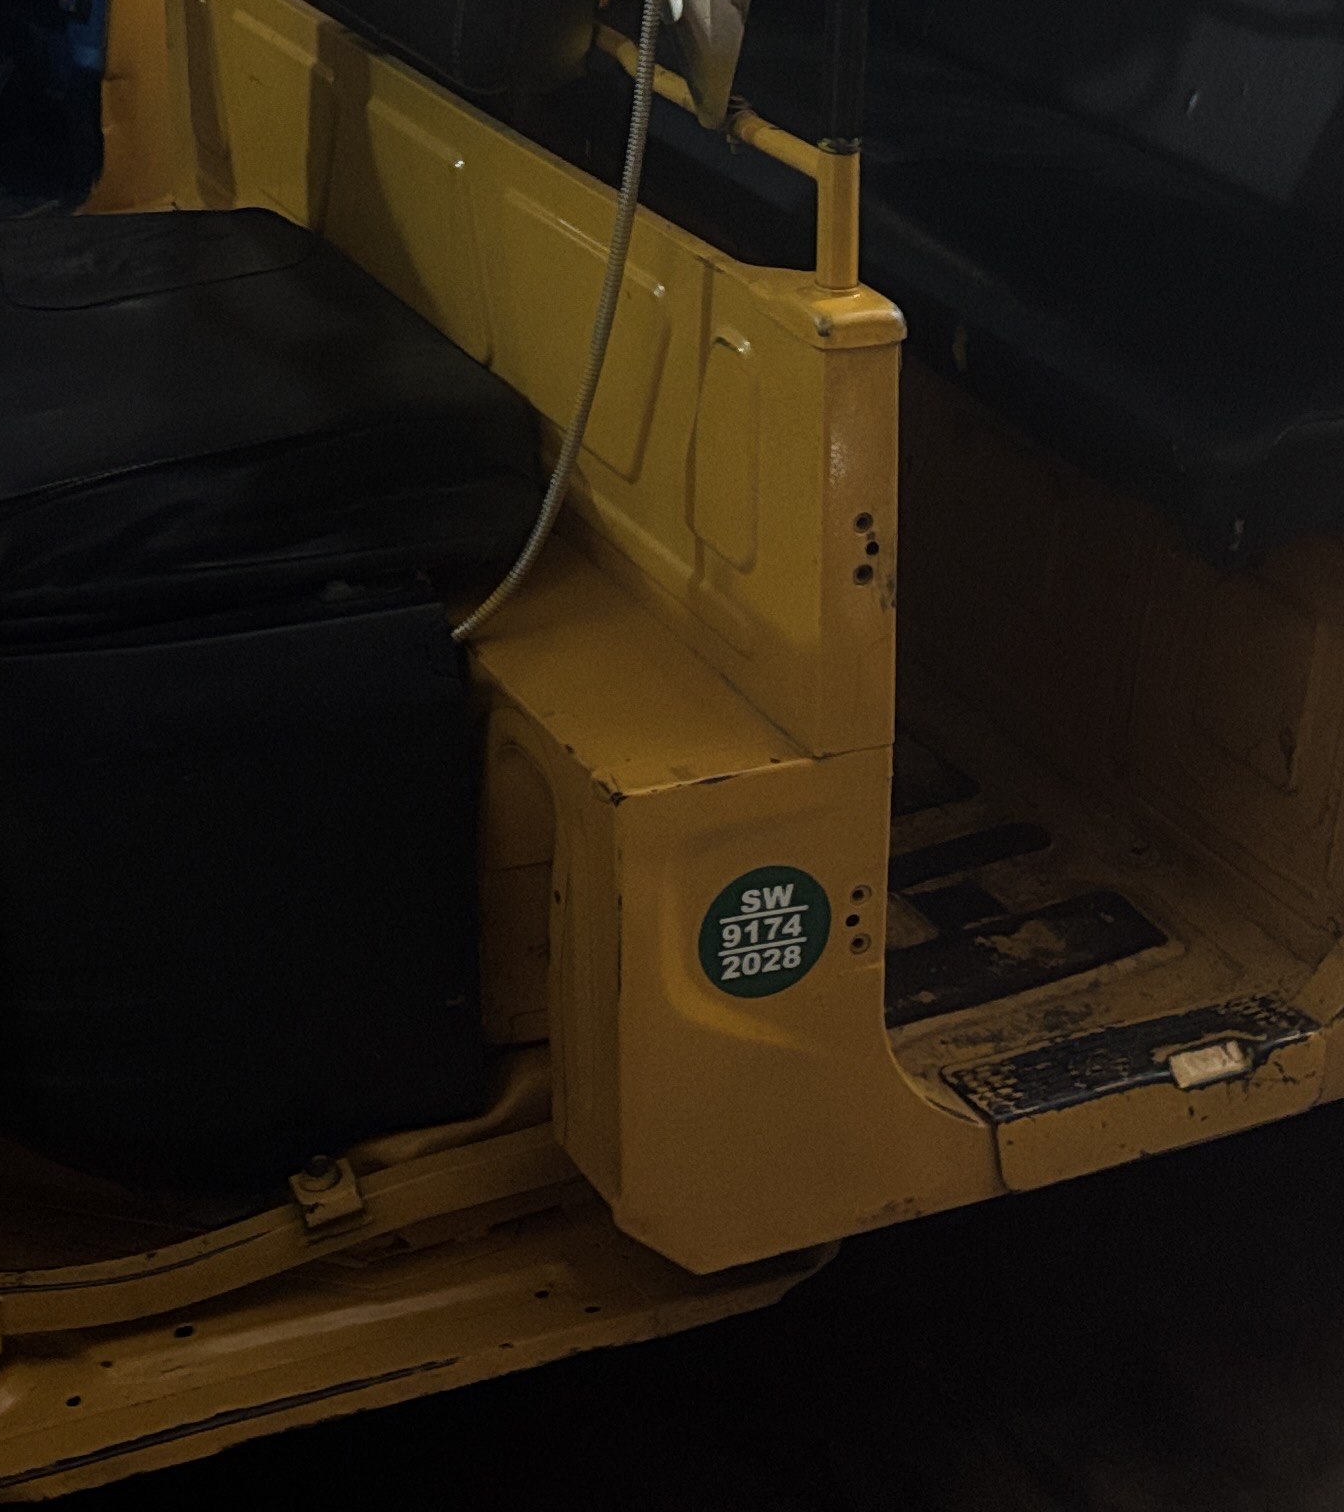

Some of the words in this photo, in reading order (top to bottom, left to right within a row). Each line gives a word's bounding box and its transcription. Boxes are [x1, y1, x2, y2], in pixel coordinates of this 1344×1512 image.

[739, 883, 795, 914] SW
[721, 914, 802, 949] 9174
[720, 945, 802, 981] 2028
